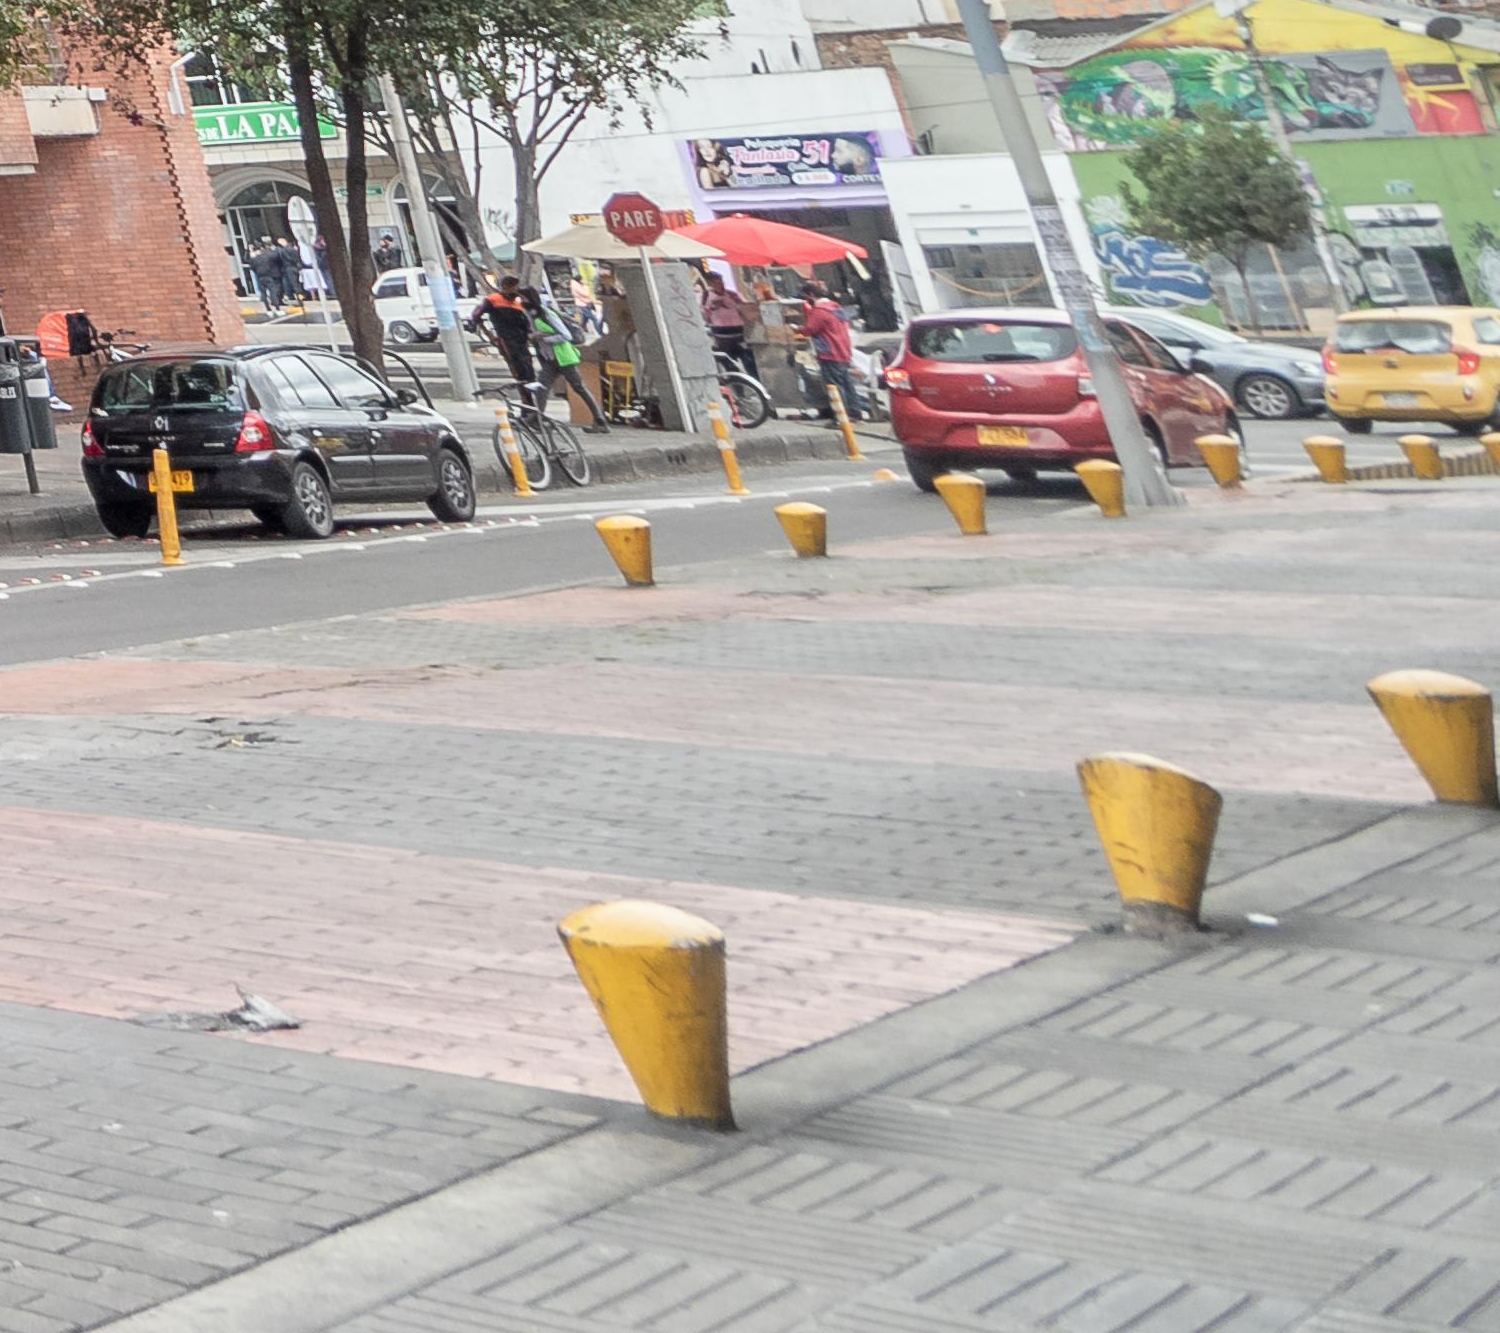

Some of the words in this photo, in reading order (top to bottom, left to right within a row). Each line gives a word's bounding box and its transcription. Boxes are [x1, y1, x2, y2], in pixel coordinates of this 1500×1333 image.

[216, 115, 257, 140] LA
[802, 139, 830, 165] 51
[610, 210, 657, 229] PARE
